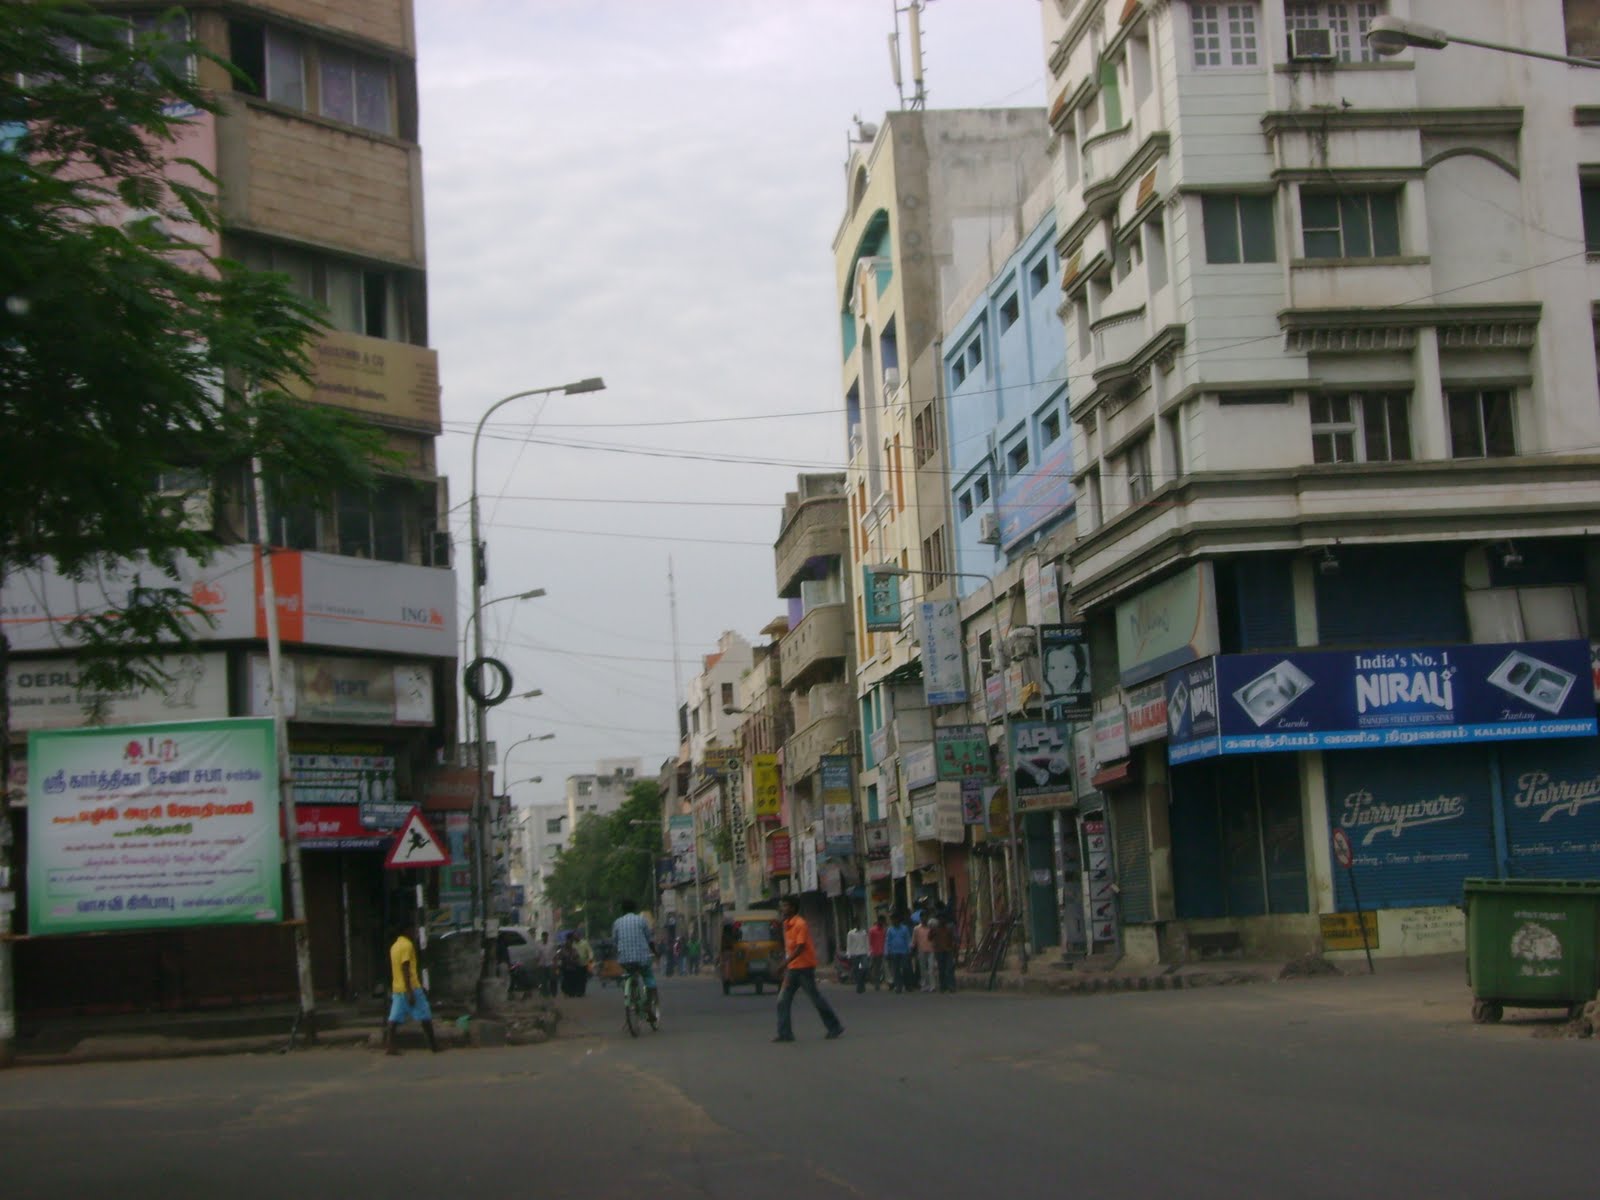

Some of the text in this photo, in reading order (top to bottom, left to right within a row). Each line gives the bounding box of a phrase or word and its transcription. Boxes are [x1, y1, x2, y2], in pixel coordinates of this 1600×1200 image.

[401, 607, 427, 623] ING
[1355, 652, 1448, 669] India's No. 1
[1474, 723, 1592, 737] KALANJIAM COMPANY
